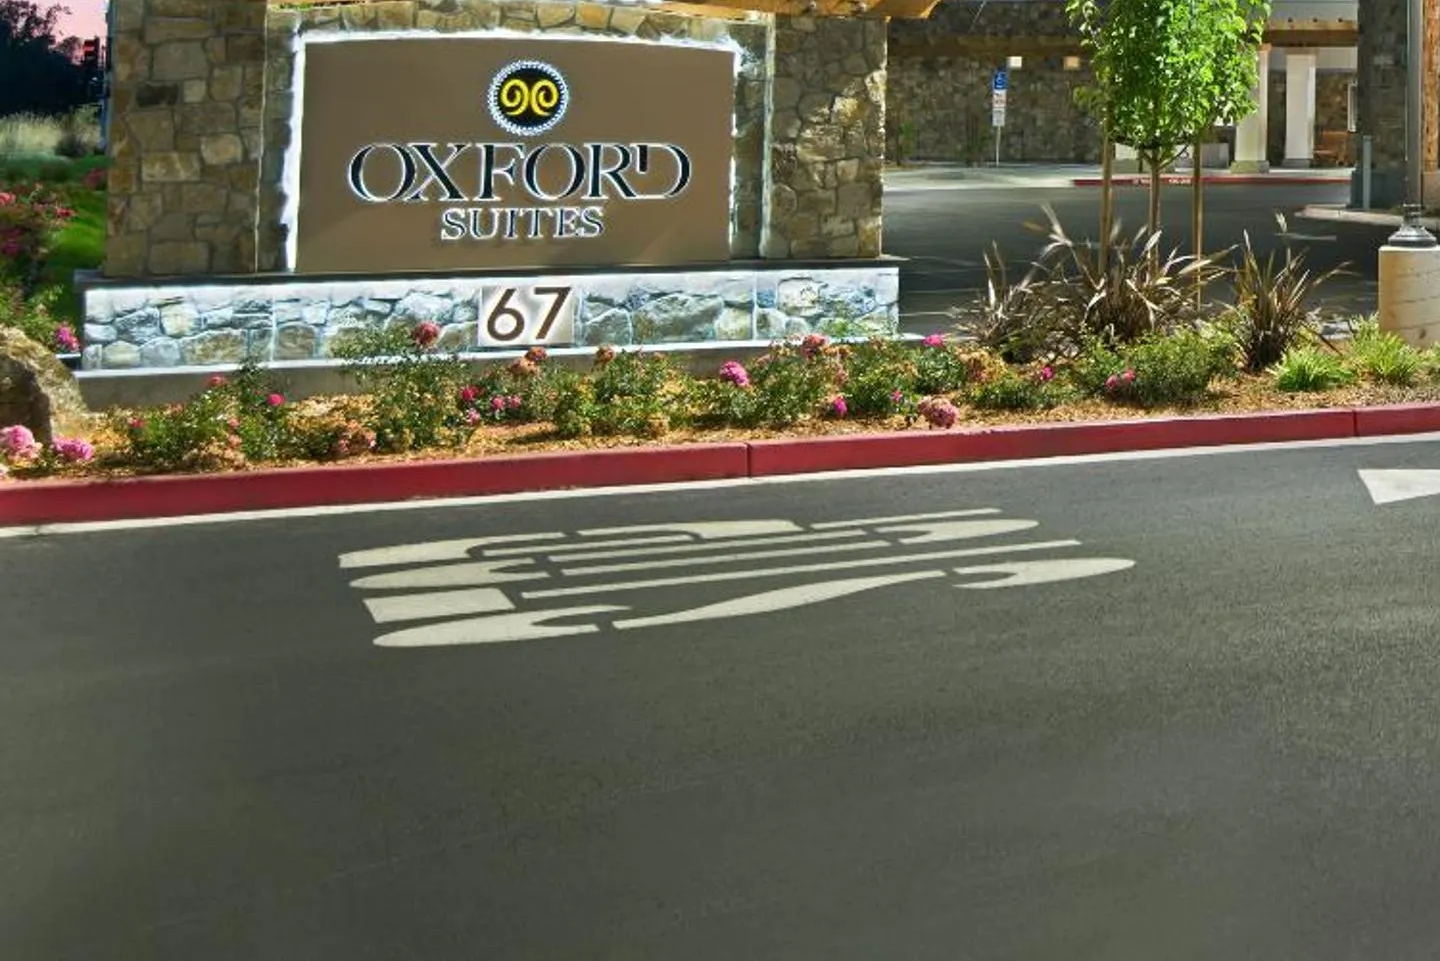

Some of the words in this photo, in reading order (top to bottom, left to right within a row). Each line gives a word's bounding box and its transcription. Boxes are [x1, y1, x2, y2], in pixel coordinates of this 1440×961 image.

[348, 142, 692, 203] OXFORD
[441, 206, 604, 241] SUITES
[486, 286, 572, 342] 67
[338, 508, 1136, 647] STOP
